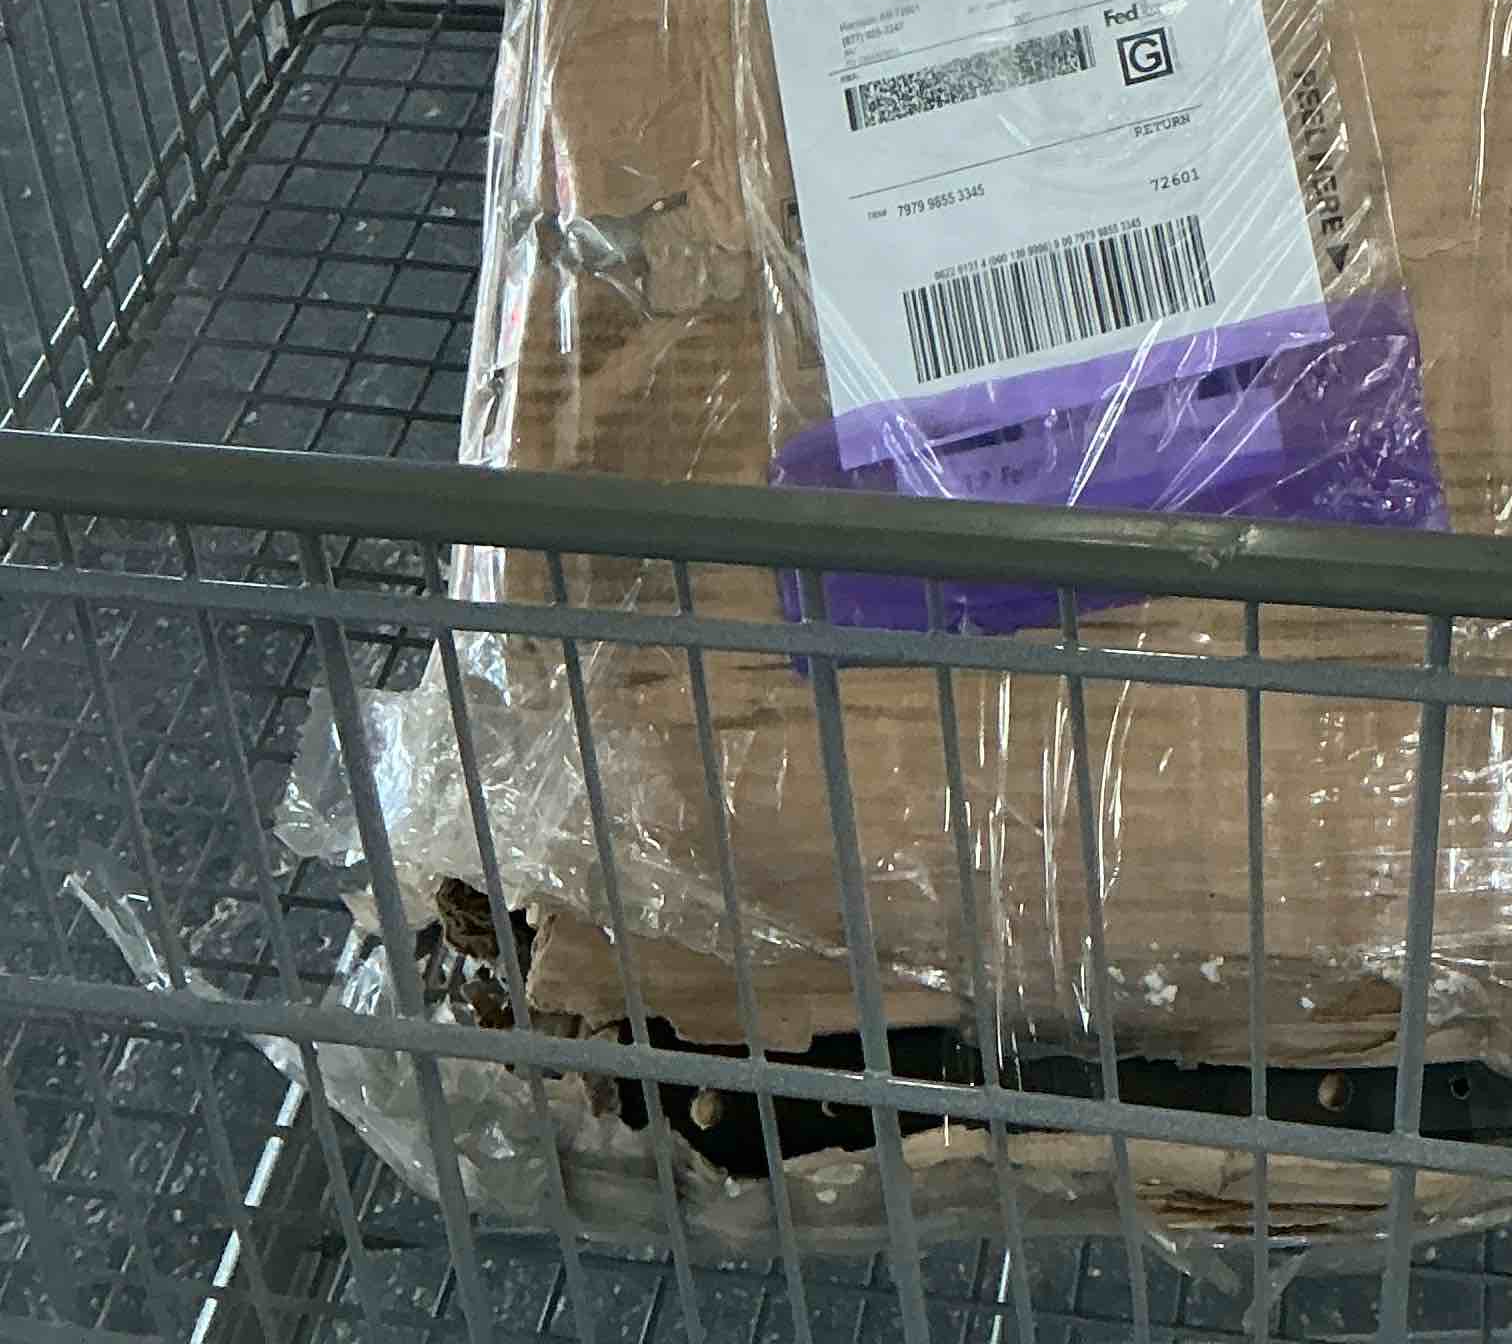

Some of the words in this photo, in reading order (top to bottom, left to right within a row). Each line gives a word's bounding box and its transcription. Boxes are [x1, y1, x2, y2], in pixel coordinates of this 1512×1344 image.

[1134, 113, 1191, 139] RETURN
[1150, 166, 1201, 192] 72601
[897, 198, 926, 218] 7979
[957, 183, 986, 204] 3345
